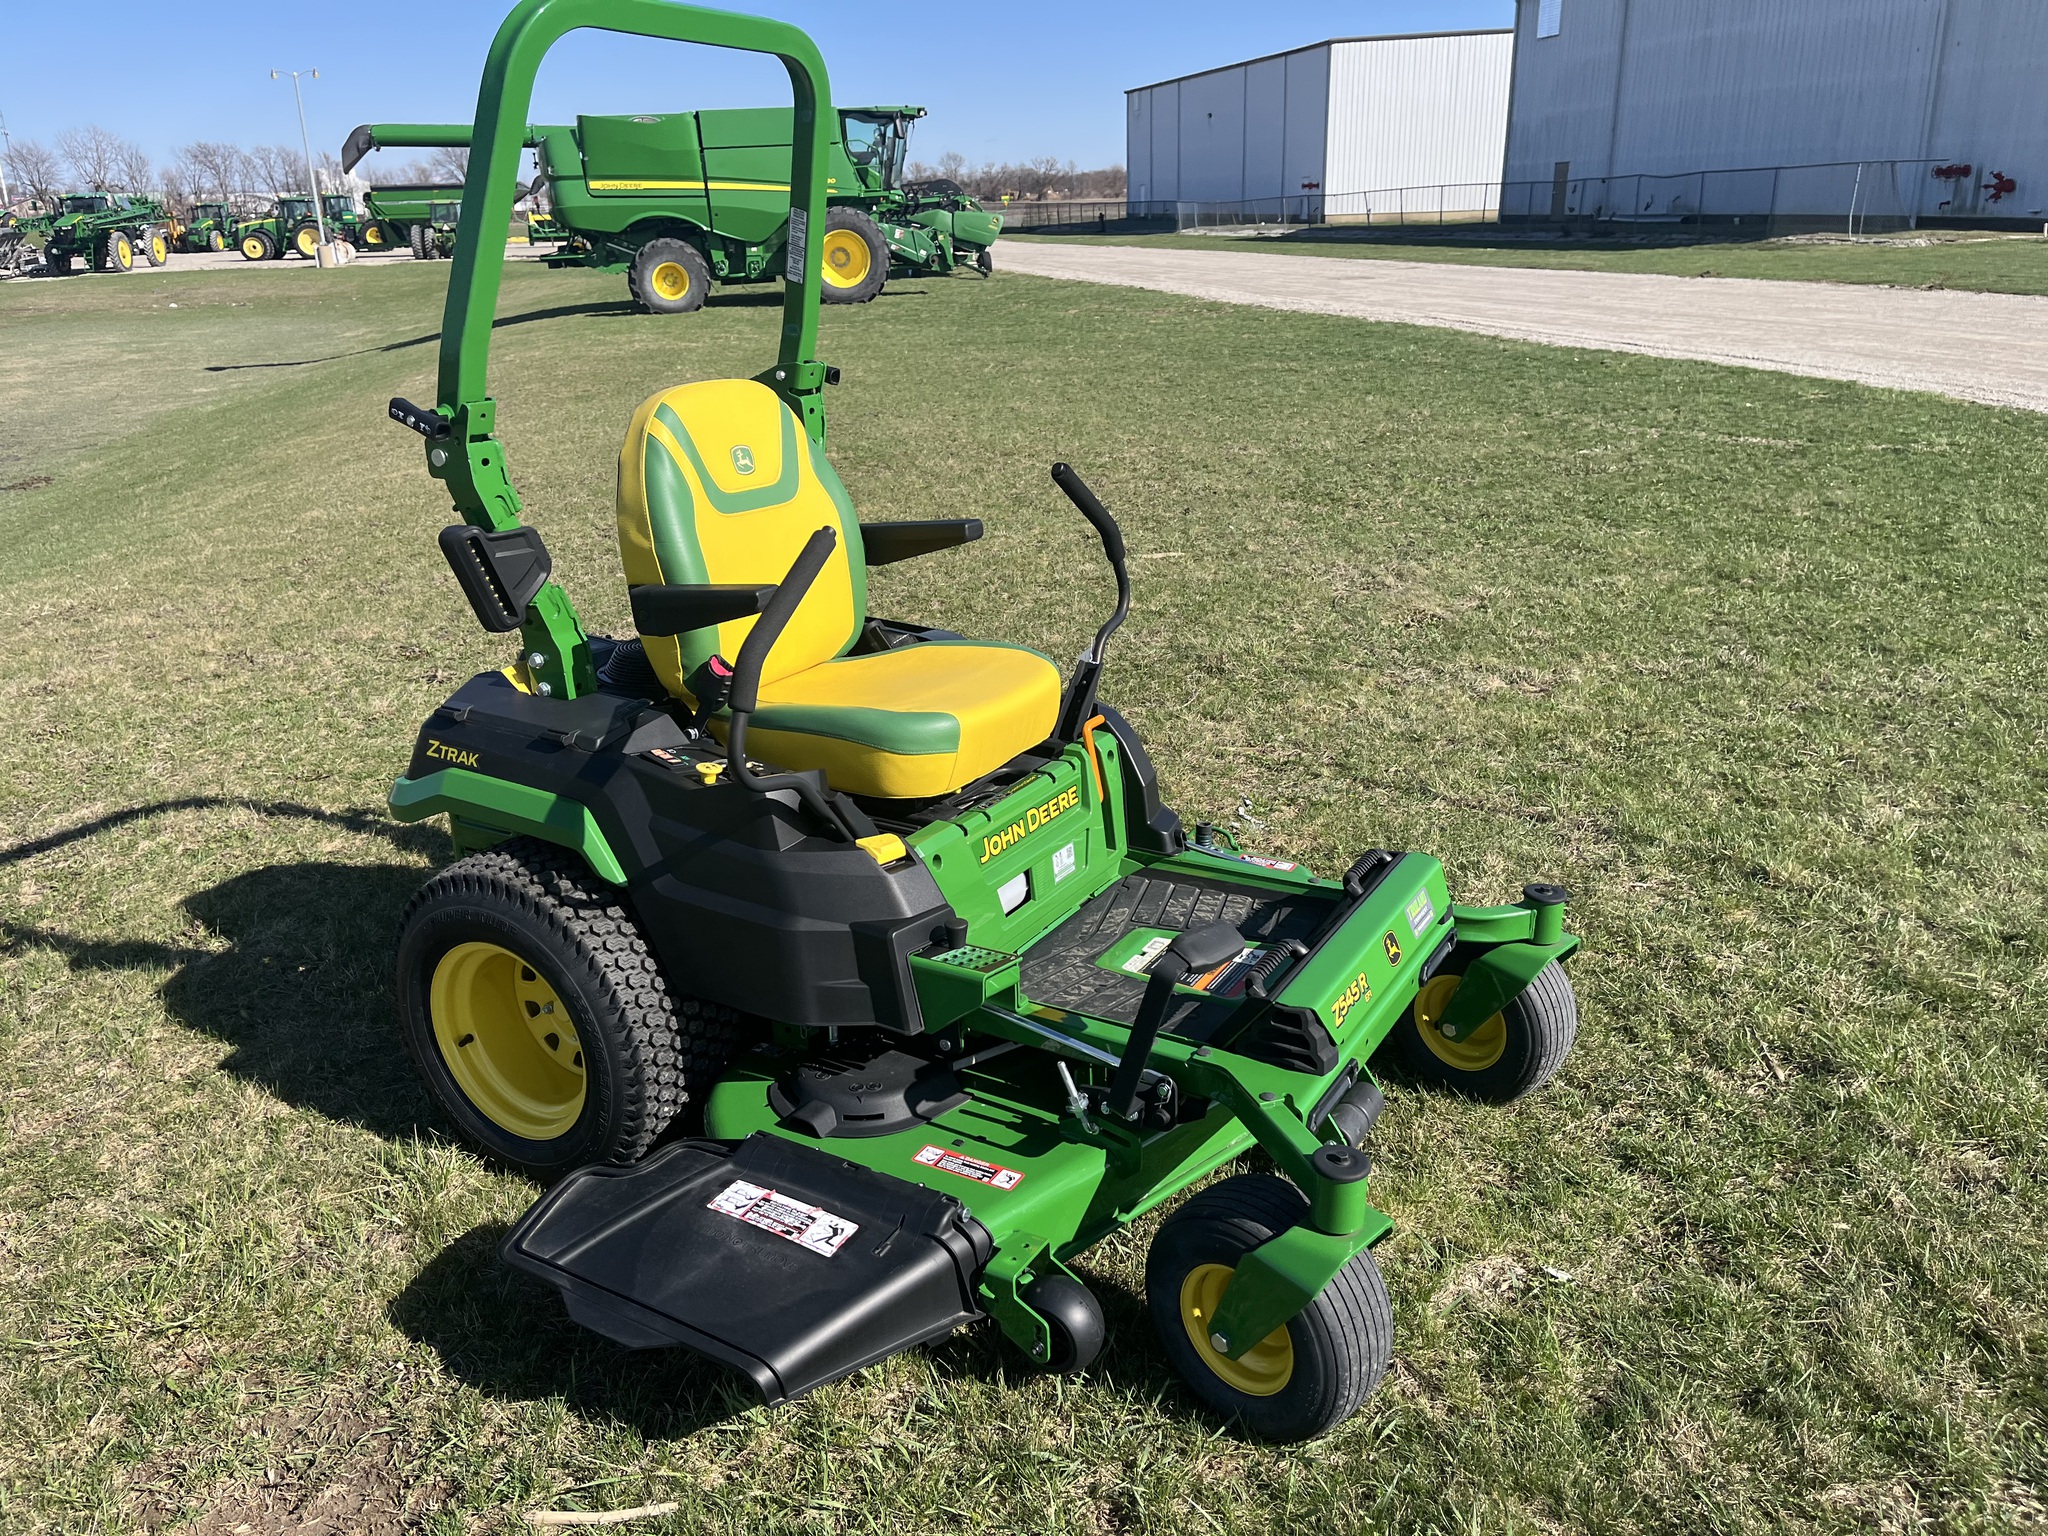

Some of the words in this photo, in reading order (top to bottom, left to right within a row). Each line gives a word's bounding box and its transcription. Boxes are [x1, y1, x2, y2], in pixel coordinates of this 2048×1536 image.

[600, 182, 619, 190] JOHN
[980, 818, 1026, 865] JOHN
[1025, 784, 1080, 834] DEERE
